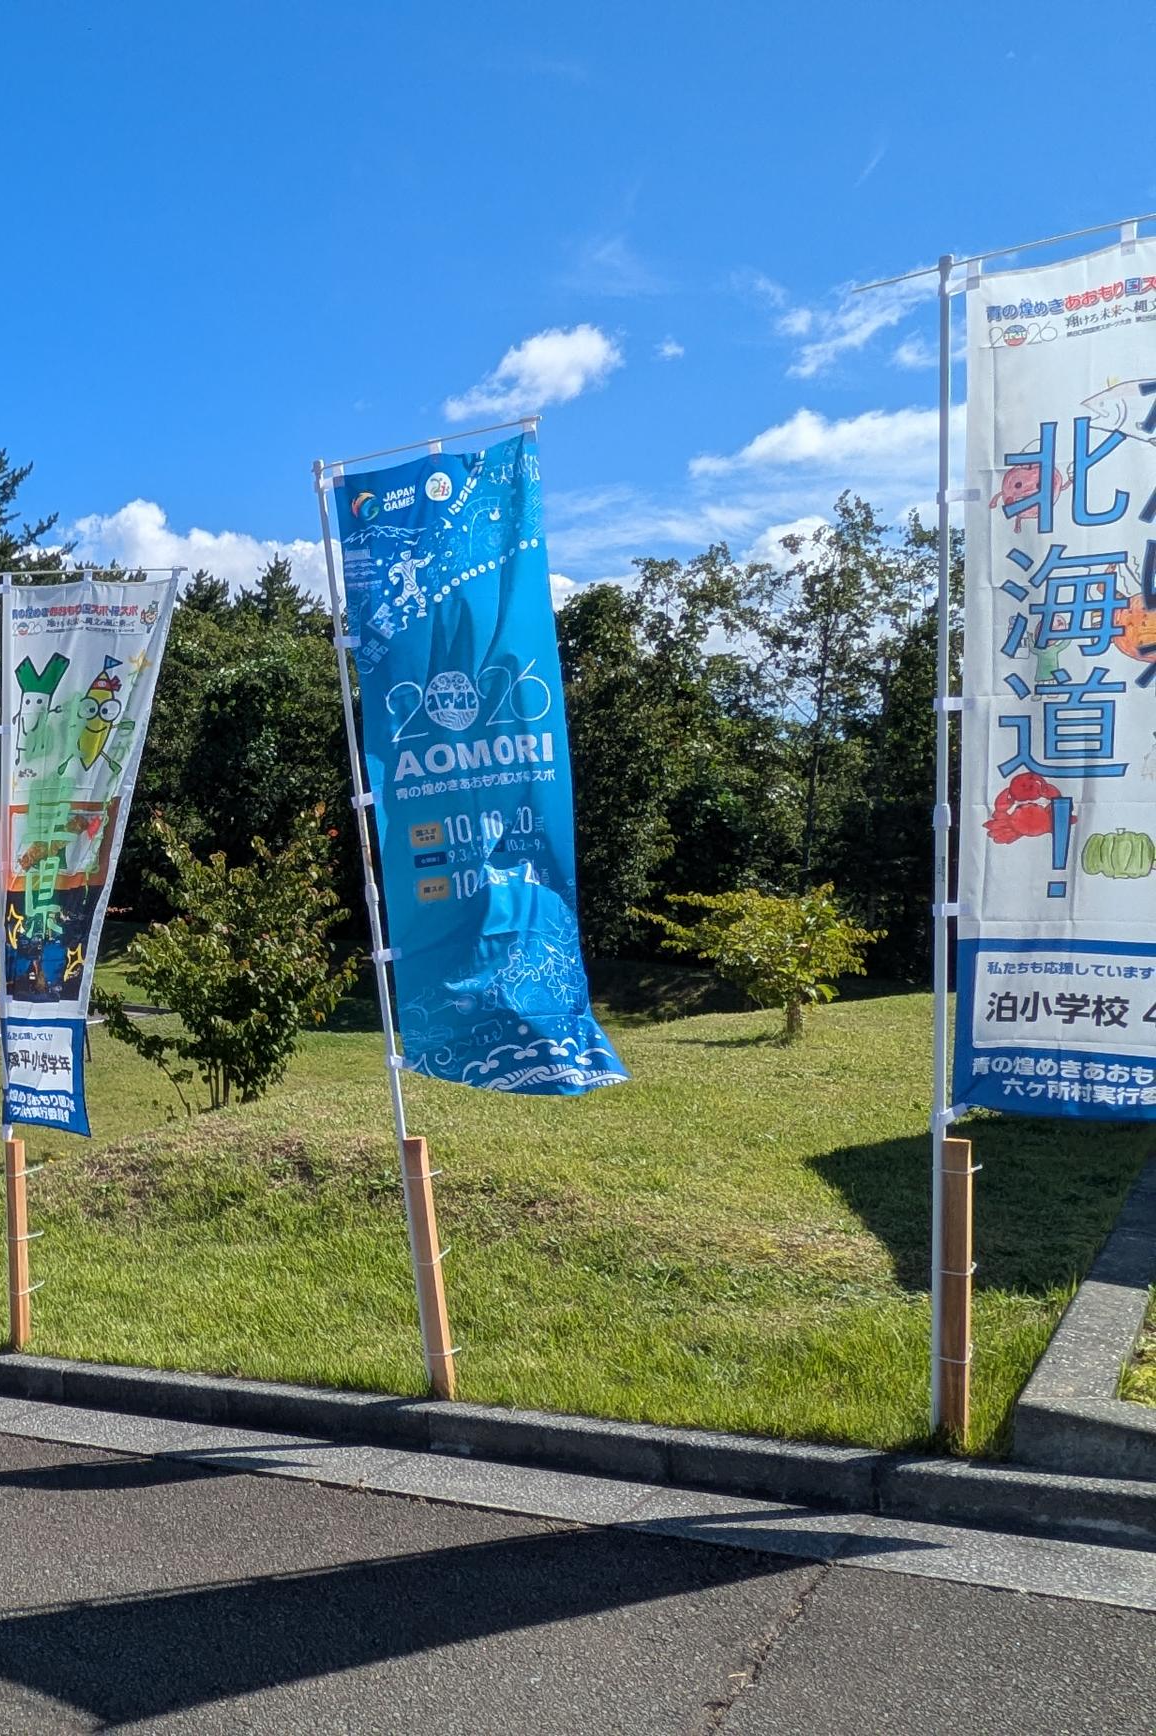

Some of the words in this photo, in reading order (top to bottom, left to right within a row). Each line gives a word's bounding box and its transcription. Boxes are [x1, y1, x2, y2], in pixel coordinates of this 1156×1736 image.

[382, 485, 416, 503] JAPAN
[383, 496, 416, 512] GAMES
[394, 732, 554, 782] AOMORI
[986, 960, 1155, 980] 私たちも応援しています
[984, 991, 1130, 1028] 泊小学校
